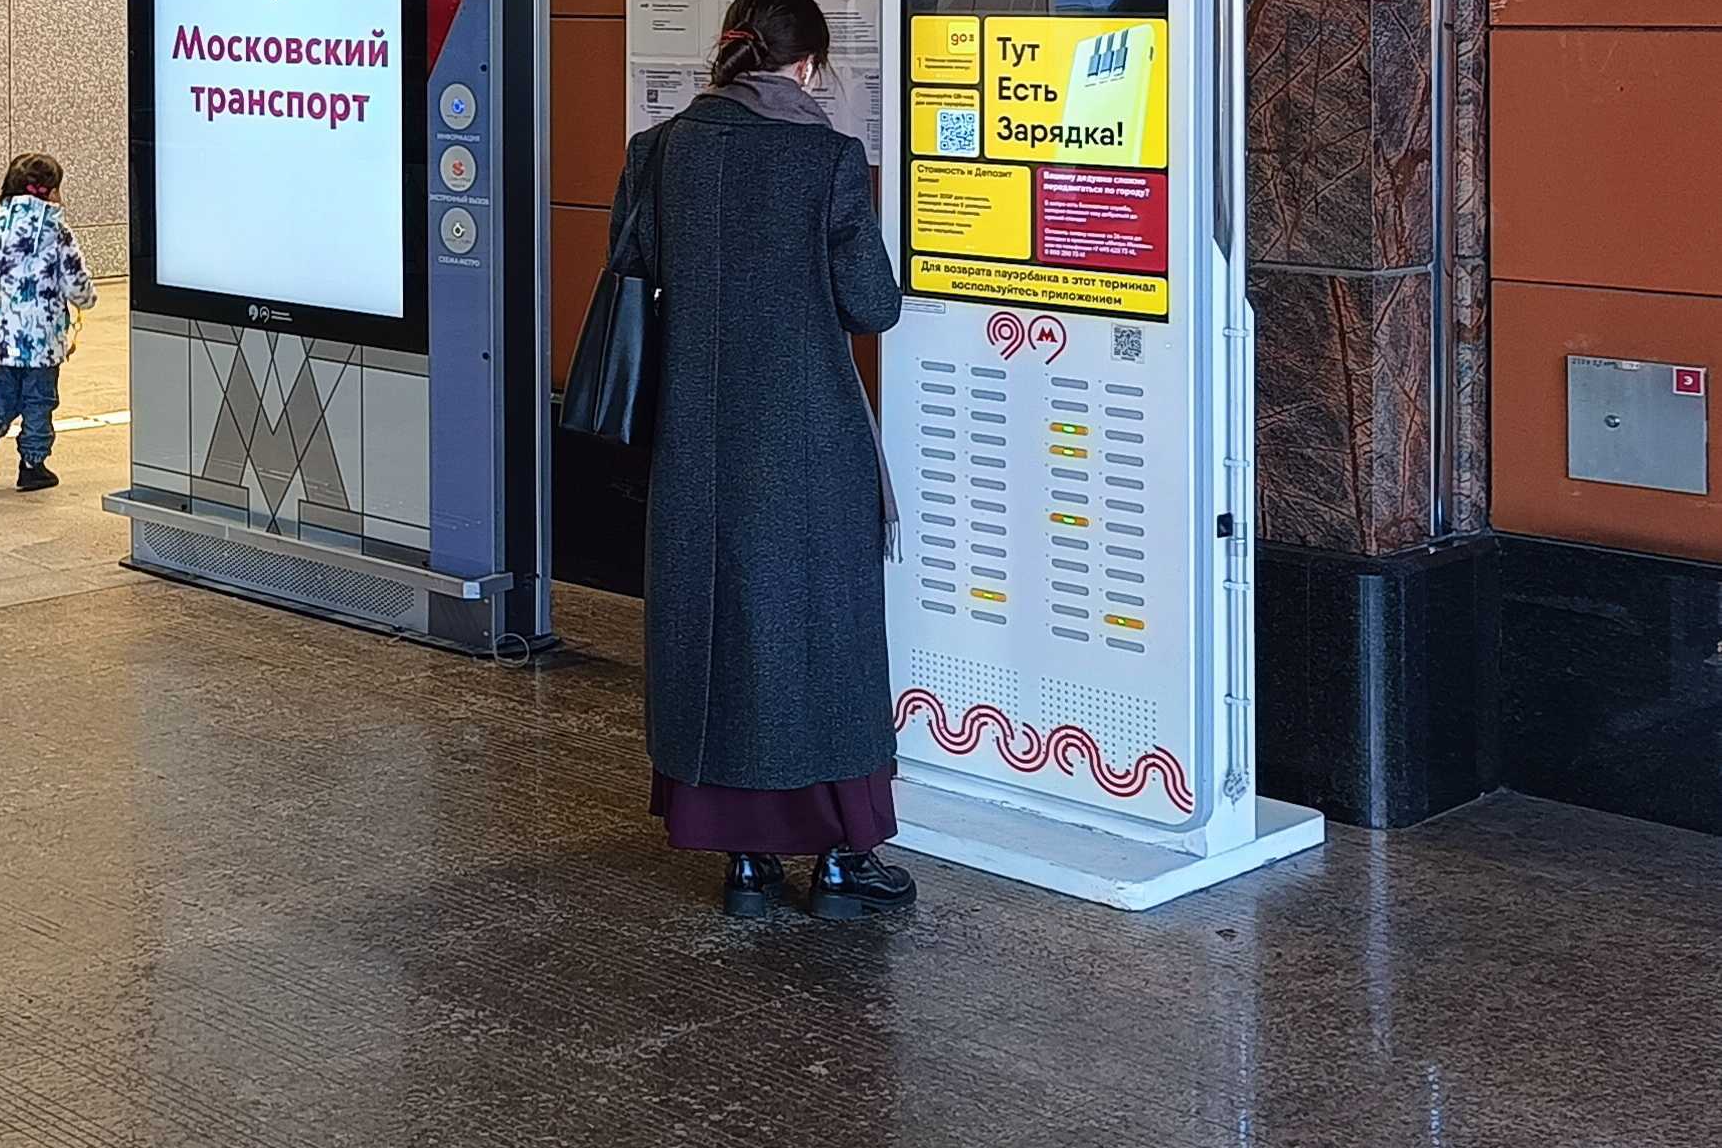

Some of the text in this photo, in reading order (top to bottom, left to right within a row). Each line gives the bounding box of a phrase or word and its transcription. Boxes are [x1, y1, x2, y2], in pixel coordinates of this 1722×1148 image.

[172, 25, 389, 68] Московский
[950, 33, 968, 46] go
[996, 36, 1040, 67] Тут
[997, 76, 1058, 102] Есть
[190, 86, 370, 130] транспорт
[996, 116, 1124, 148] Зарядка!
[921, 260, 1156, 293] Для возврата пауэрбанка в этот терминал
[951, 280, 1122, 306] воспользуйтесь приложением
